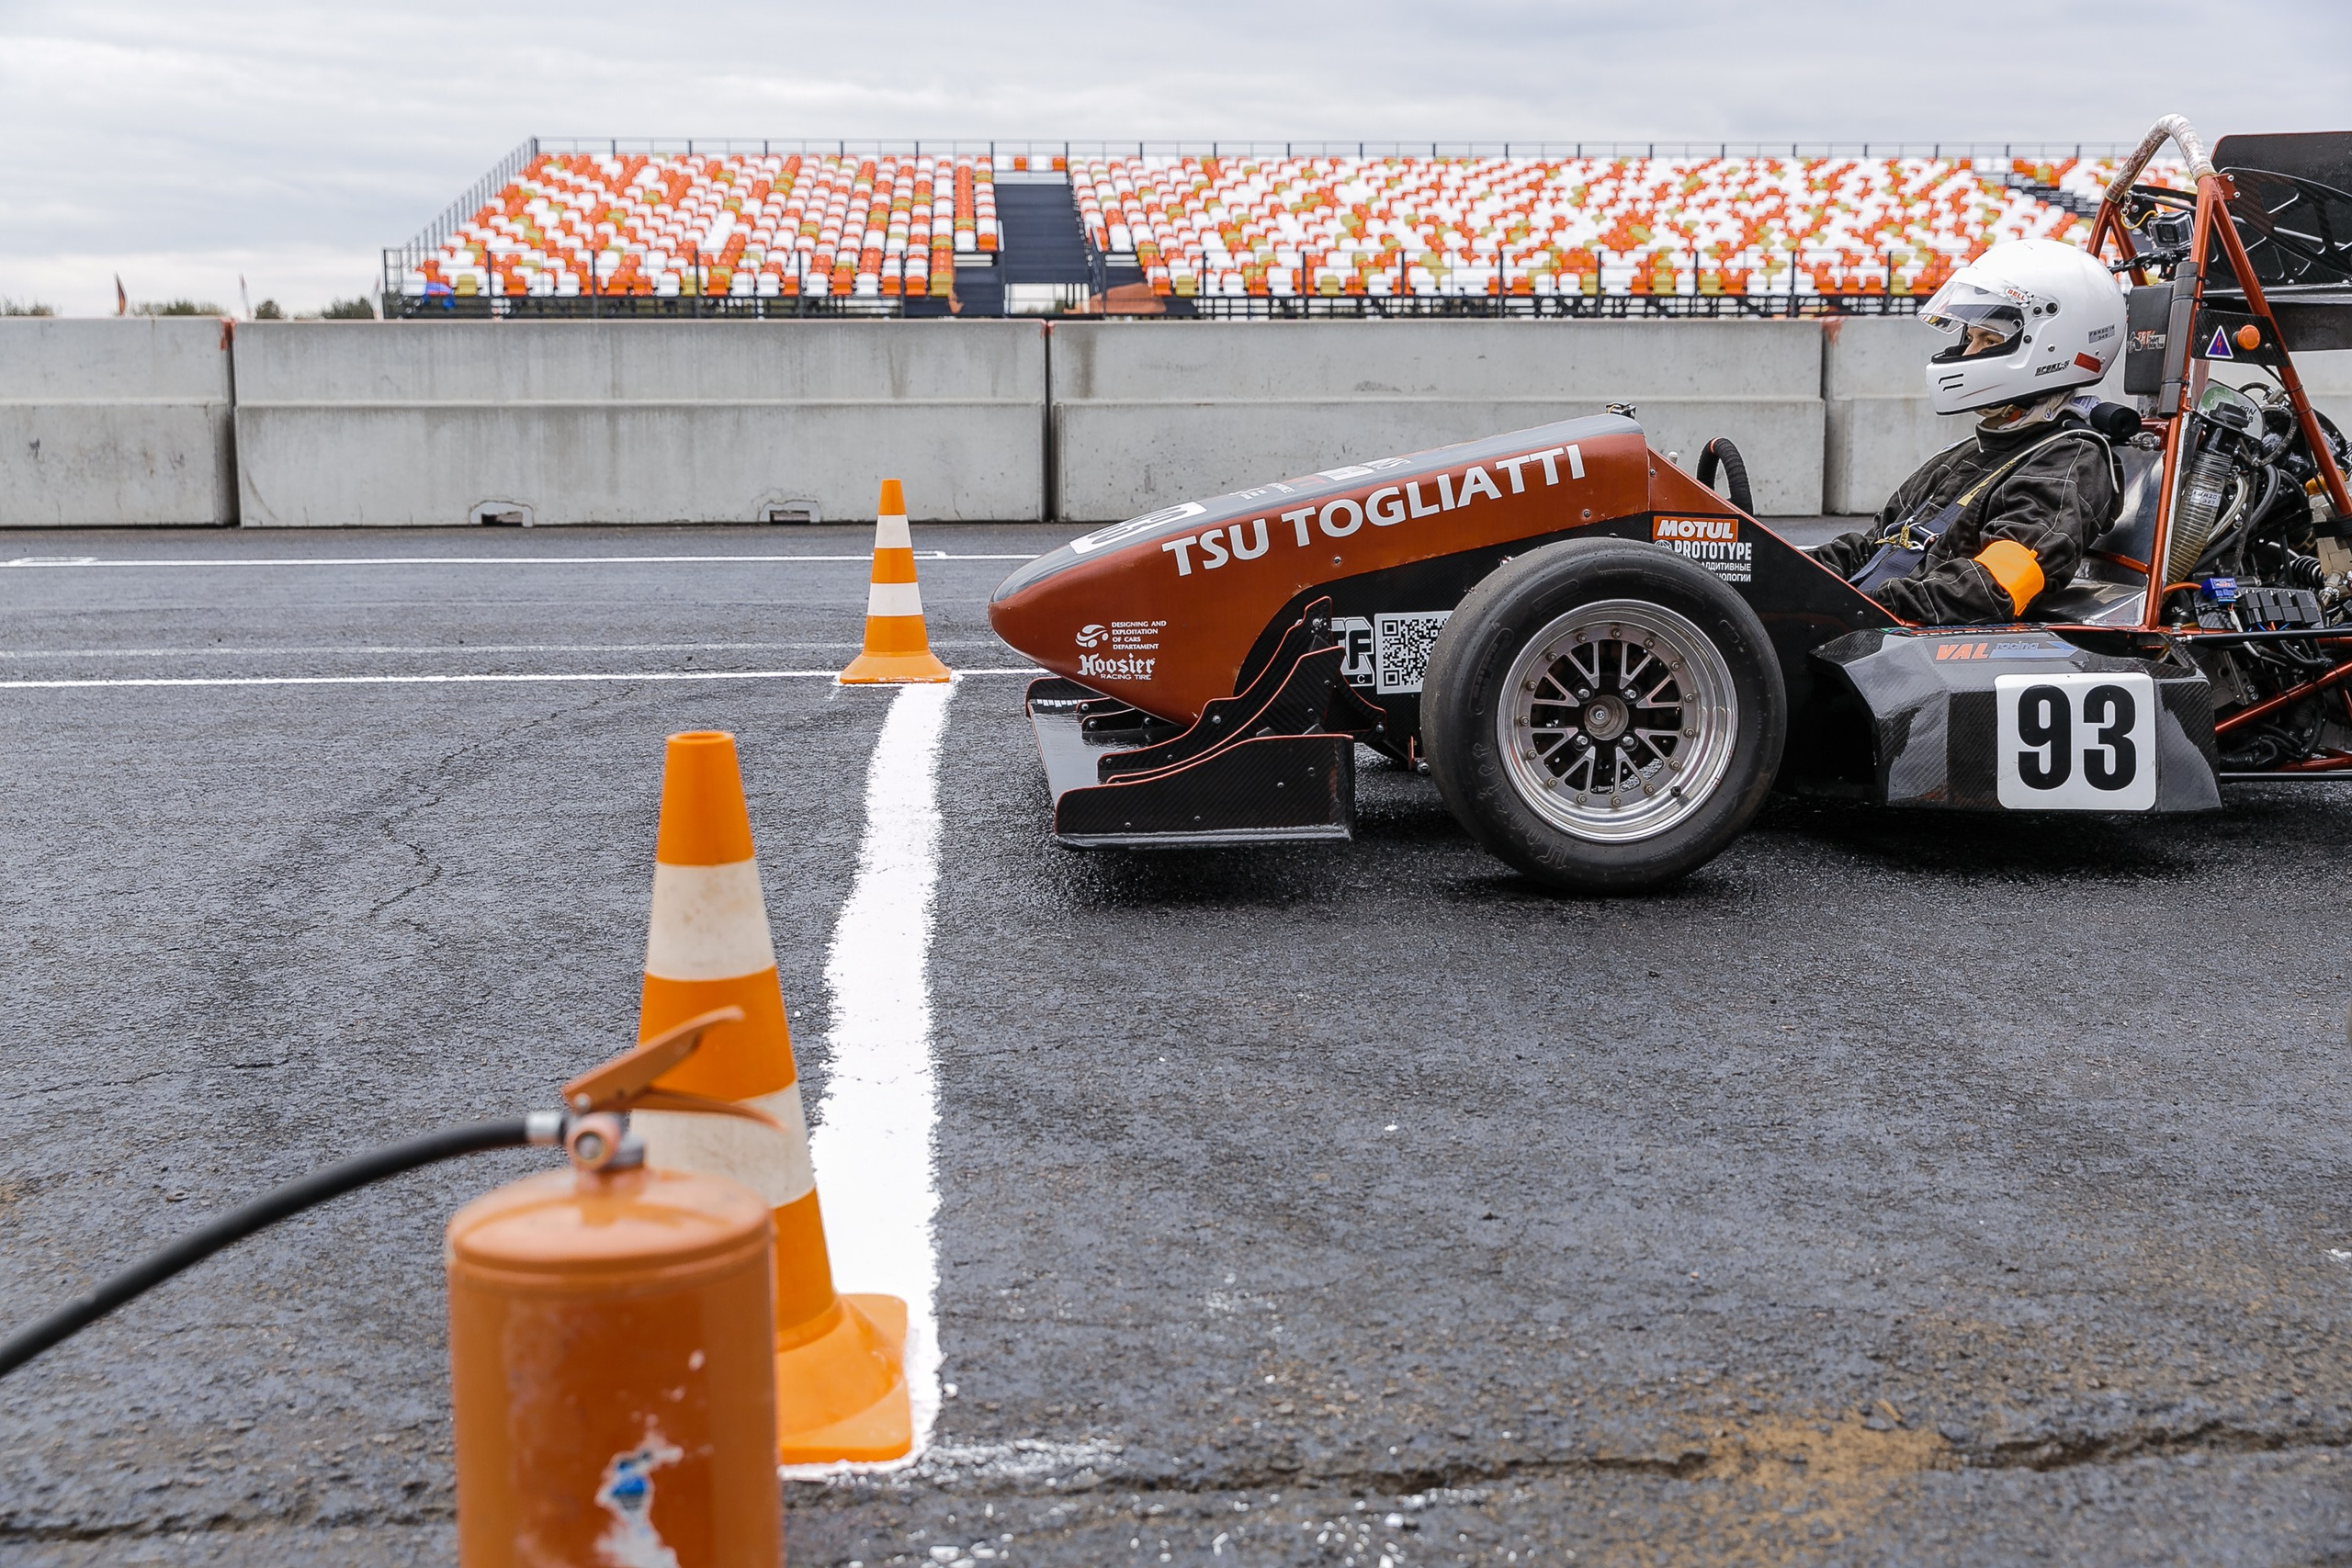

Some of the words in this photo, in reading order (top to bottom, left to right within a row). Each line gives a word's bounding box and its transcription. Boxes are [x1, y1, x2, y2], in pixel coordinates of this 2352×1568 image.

[2007, 288, 2026, 301] BELL
[1162, 518, 1269, 577] TSU
[1282, 444, 1586, 547] TOGLIATTI
[1657, 519, 1734, 539] MOTUL
[1674, 540, 1752, 560] PROTOTYPE
[1935, 642, 1989, 660] VAL
[1077, 652, 1156, 676] Hoosier
[2017, 684, 2138, 791] 93
